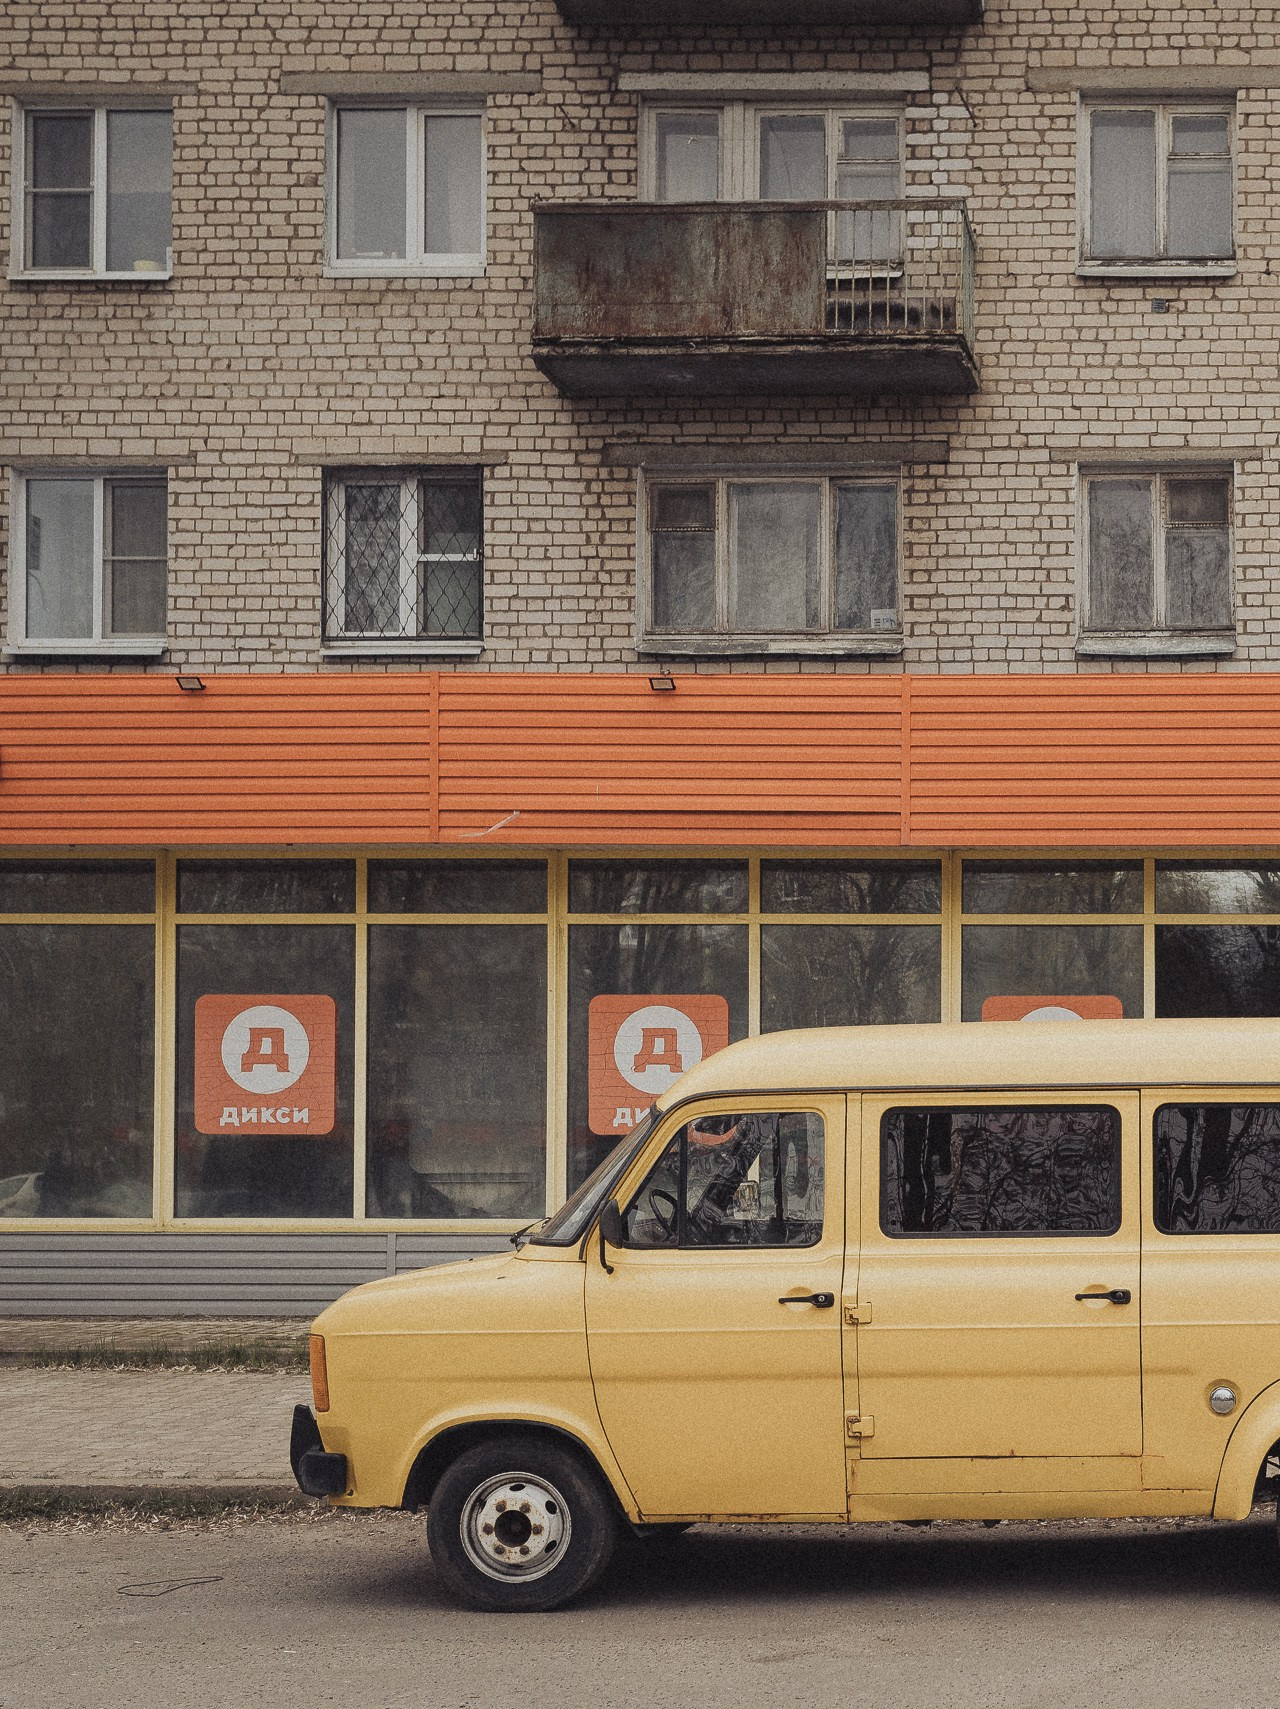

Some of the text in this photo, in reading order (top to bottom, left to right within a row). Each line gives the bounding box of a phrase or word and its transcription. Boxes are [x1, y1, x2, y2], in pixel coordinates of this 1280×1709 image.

[241, 1027, 290, 1072] Д
[634, 1027, 683, 1072] Д
[219, 1107, 309, 1127] ДИКСИ
